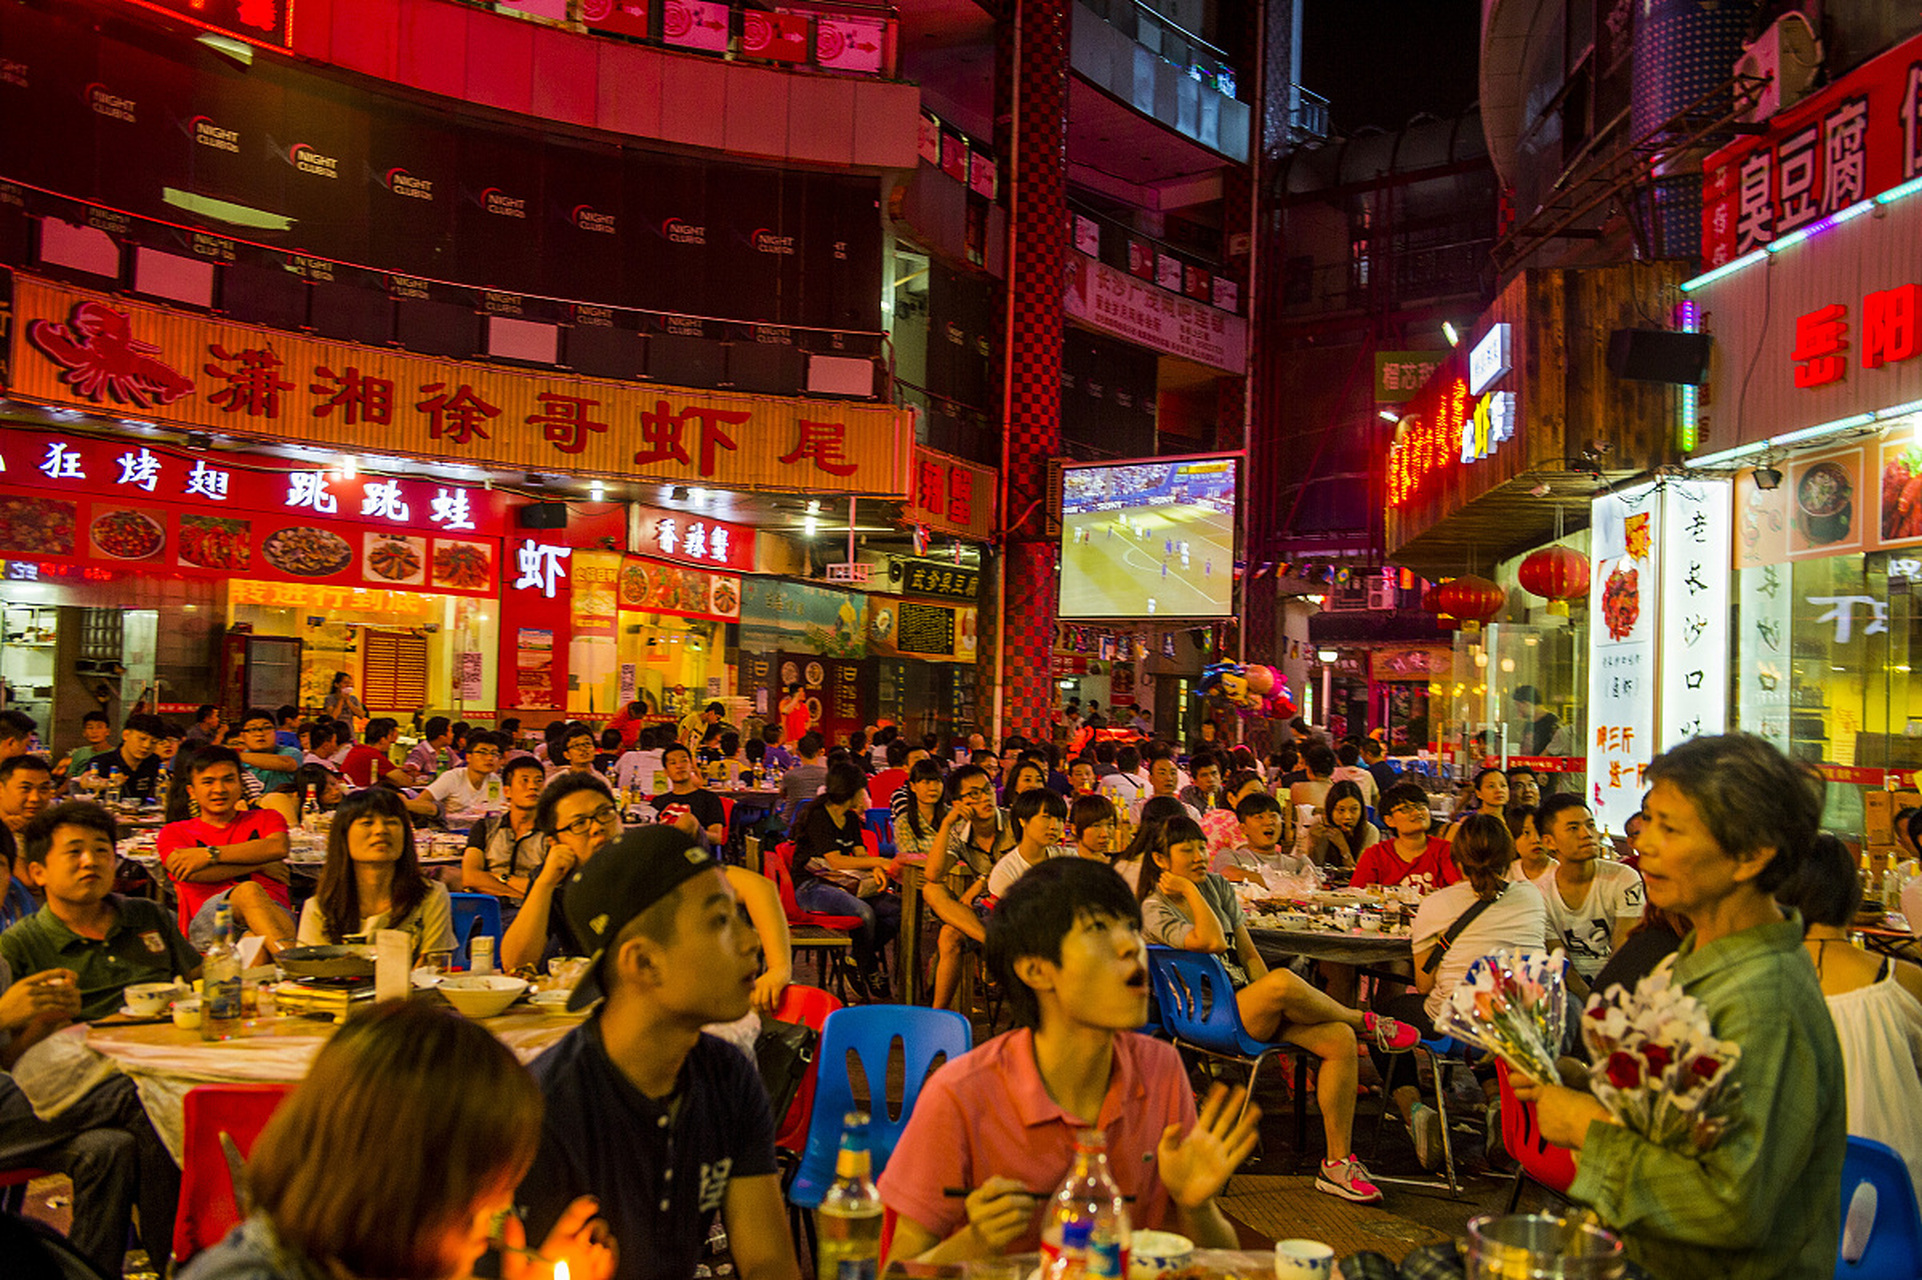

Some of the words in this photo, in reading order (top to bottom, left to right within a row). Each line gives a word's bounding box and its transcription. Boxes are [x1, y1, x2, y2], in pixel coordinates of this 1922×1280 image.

[197, 122, 239, 142] NIGHT
[298, 150, 338, 168] NIGHT
[394, 174, 433, 191] NIGHT
[1737, 95, 1868, 254] 臭豆腐
[487, 194, 525, 210] NIGHT
[580, 211, 616, 225] NIGHT
[670, 225, 705, 237] NIGHT
[759, 234, 794, 246] NIGHT
[578, 304, 613, 319] NIGHT
[1791, 284, 1922, 390] 岳阳
[205, 344, 858, 478] 潇湘徐哥虾尾
[0, 442, 229, 501] 狂烤翅
[284, 468, 477, 530] 跳跳蛙
[515, 538, 572, 598] 虾
